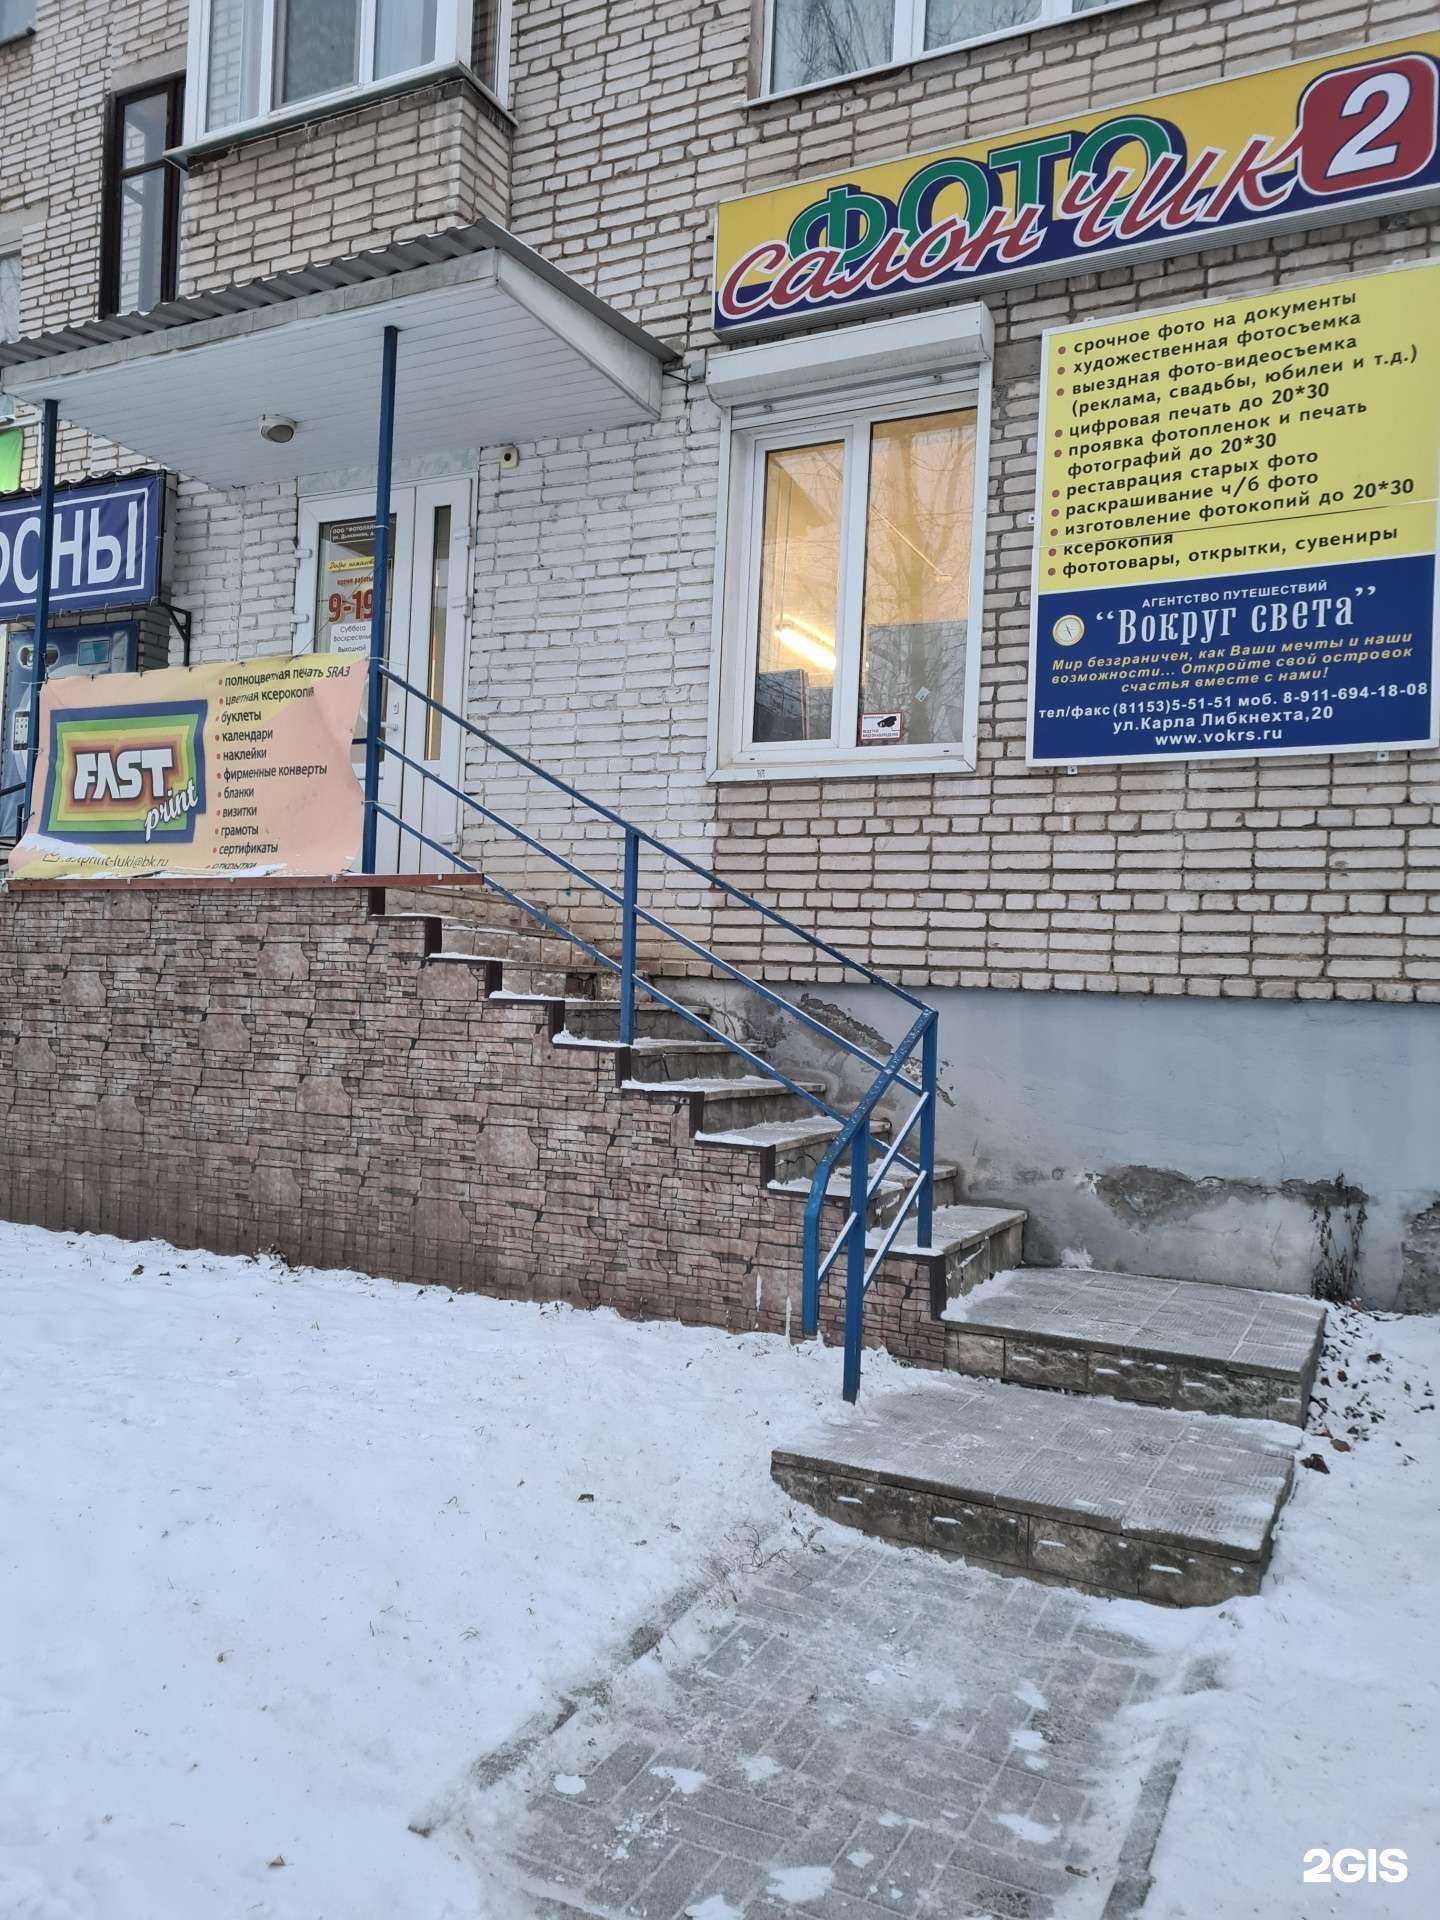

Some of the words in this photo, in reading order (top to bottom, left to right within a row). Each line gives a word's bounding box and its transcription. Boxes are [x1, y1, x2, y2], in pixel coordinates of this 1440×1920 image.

[1325, 72, 1411, 178] 2
[787, 115, 1182, 276] ФОТО
[1073, 330, 1150, 355] срочное
[1158, 320, 1205, 341] фото
[1213, 314, 1236, 328] на
[1244, 292, 1356, 325] документы
[1073, 336, 1228, 375] художественная
[1237, 313, 1361, 347] фотосъемка
[1072, 370, 1160, 395] выездная
[1168, 337, 1357, 381] фото-видеосъемка
[1072, 391, 1161, 417] (реклама,
[1169, 373, 1256, 398] свадьбы,
[1265, 360, 1343, 383] юбилеи
[1353, 357, 1364, 369] и
[1374, 344, 1417, 366] т.д.)
[1068, 436, 1144, 458] проявка
[1151, 416, 1270, 446] фотопленок
[1279, 413, 1290, 425] и
[1300, 402, 1367, 421] печать
[1069, 413, 1160, 438] цифровая
[1168, 401, 1231, 421] печать
[1239, 397, 1263, 412] до
[1067, 470, 1182, 499] реставрация
[1190, 460, 1259, 478] старых
[1268, 452, 1319, 471] фото
[1068, 447, 1181, 479] фотографий
[1189, 445, 1213, 461] до
[1065, 511, 1191, 536] изготовление
[1199, 491, 1309, 521] фотокопий
[1319, 491, 1344, 506] до
[1066, 487, 1213, 519] раскрашивание
[1222, 476, 1259, 498] ч/б
[1268, 473, 1319, 492] фото
[1063, 534, 1173, 556] ксерокопия
[1063, 553, 1180, 578] фототовары,
[1188, 542, 1286, 562] открытки,
[1296, 528, 1397, 552] сувениры
[1142, 591, 1220, 608] АГЕНТСТВО
[1223, 579, 1328, 600] ПУТЕШЕСТВИЙ
[340, 625, 366, 634] Суббота
[1051, 666, 1175, 684] возможности...
[1181, 658, 1271, 674] Откройте
[1276, 653, 1317, 667] свой
[1322, 648, 1413, 664] островок
[1052, 659, 1083, 672] Мир
[1087, 651, 1193, 669] безграничен,
[1199, 647, 1225, 658] как
[1230, 642, 1276, 656] Ваши
[1281, 637, 1343, 653] мечты
[1349, 636, 1359, 646] и
[1364, 633, 1412, 645] наши
[292, 667, 324, 680] печать
[326, 666, 350, 678] SRA3
[1121, 677, 1189, 693] счастья
[1195, 675, 1259, 688] вместе
[1264, 673, 1273, 682] с
[1278, 667, 1329, 681] нами!
[225, 691, 259, 706] цветная
[1039, 705, 1110, 720] тел/факс
[1113, 696, 1231, 716] (81153)5-51-51
[1238, 693, 1277, 707] моб.
[1283, 683, 1428, 704] 8-911-694-18-08
[221, 710, 262, 726] буклеты
[222, 729, 273, 742] календари
[1113, 716, 1195, 734] ул.Карла
[223, 747, 267, 761] наклейки
[1155, 729, 1282, 745] www.vokrs.ru
[73, 748, 172, 800] FAST
[223, 767, 276, 782] фирменные
[278, 765, 328, 777] конверты
[144, 777, 199, 843] print
[223, 786, 254, 799] бланки
[222, 806, 257, 818] визитки
[218, 841, 279, 857] сертификаты
[221, 825, 259, 838] грамоты
